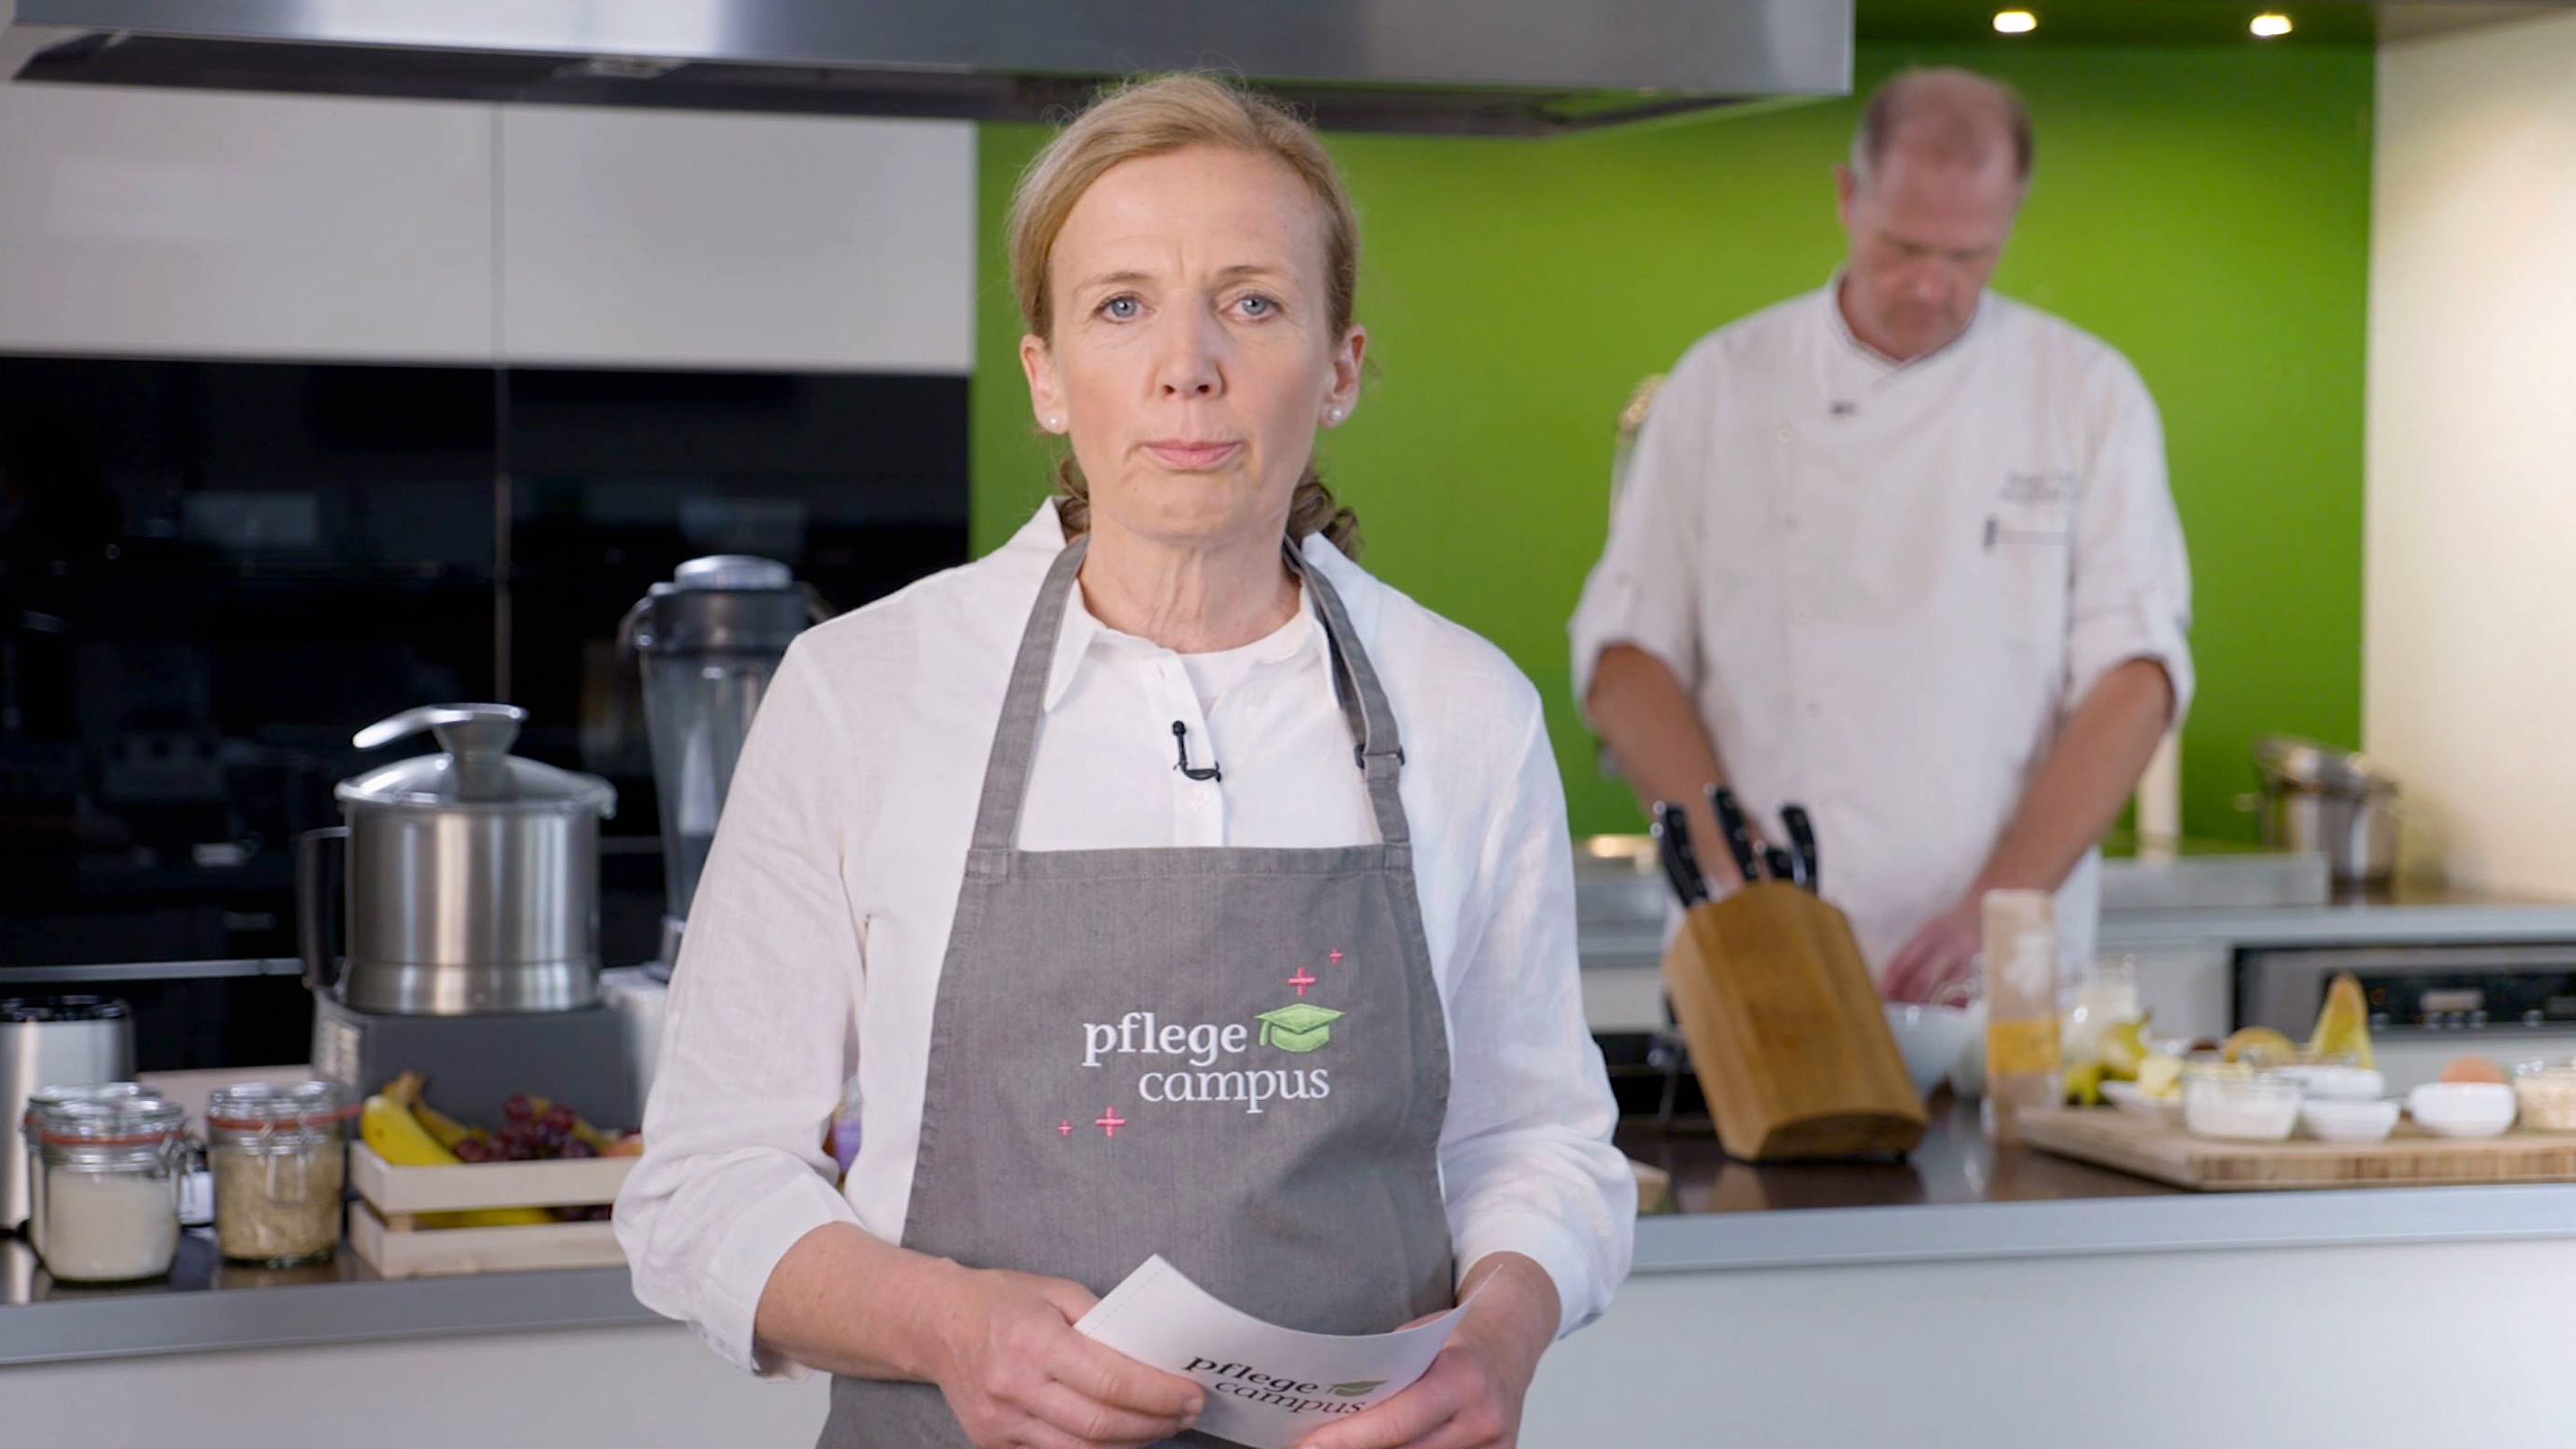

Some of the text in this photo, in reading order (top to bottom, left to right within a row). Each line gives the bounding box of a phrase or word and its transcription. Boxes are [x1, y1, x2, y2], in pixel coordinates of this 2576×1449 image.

[1081, 1012, 1248, 1067] pflege
[1138, 1069, 1330, 1114] campus
[1183, 1356, 1319, 1394] pflege
[1215, 1382, 1366, 1415] campus
